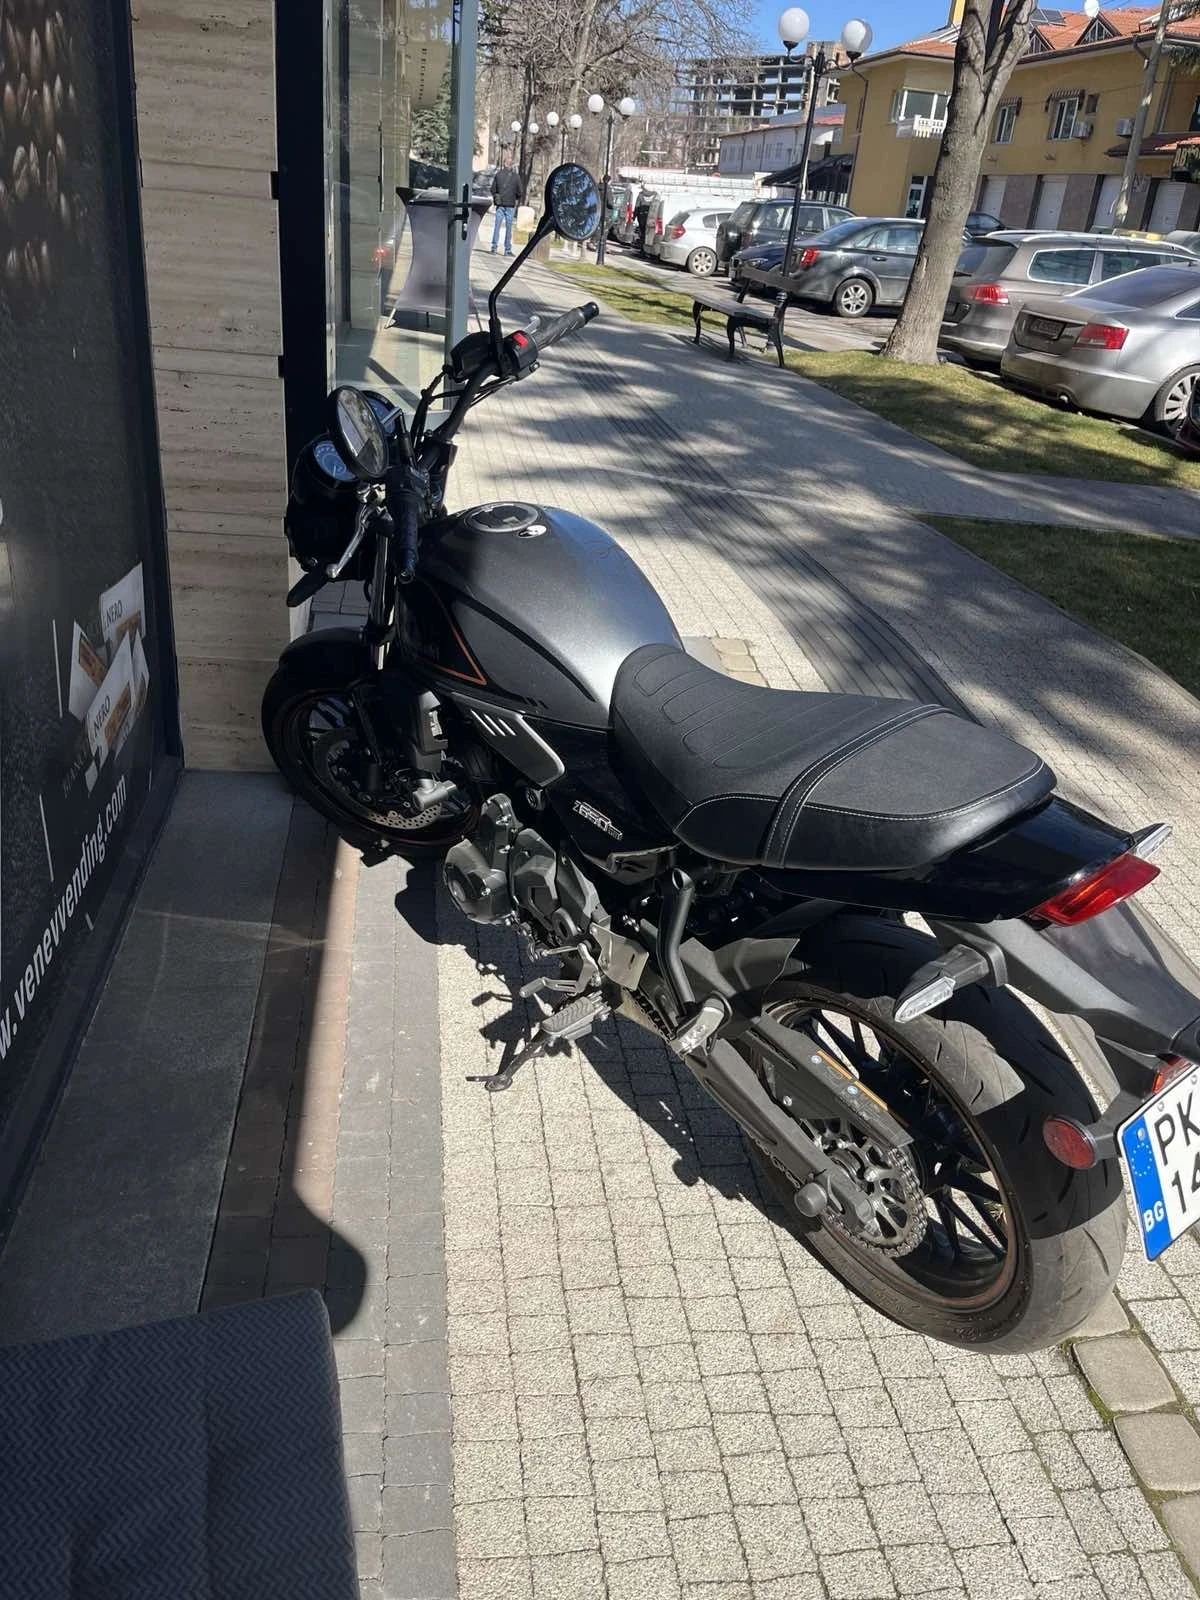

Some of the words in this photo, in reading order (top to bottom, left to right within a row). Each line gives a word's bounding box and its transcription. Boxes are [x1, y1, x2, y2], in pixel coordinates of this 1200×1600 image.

[106, 599, 123, 628] NERO
[93, 695, 111, 737] NERO
[1153, 1092, 1200, 1166] PK
[1143, 1201, 1166, 1233] BG
